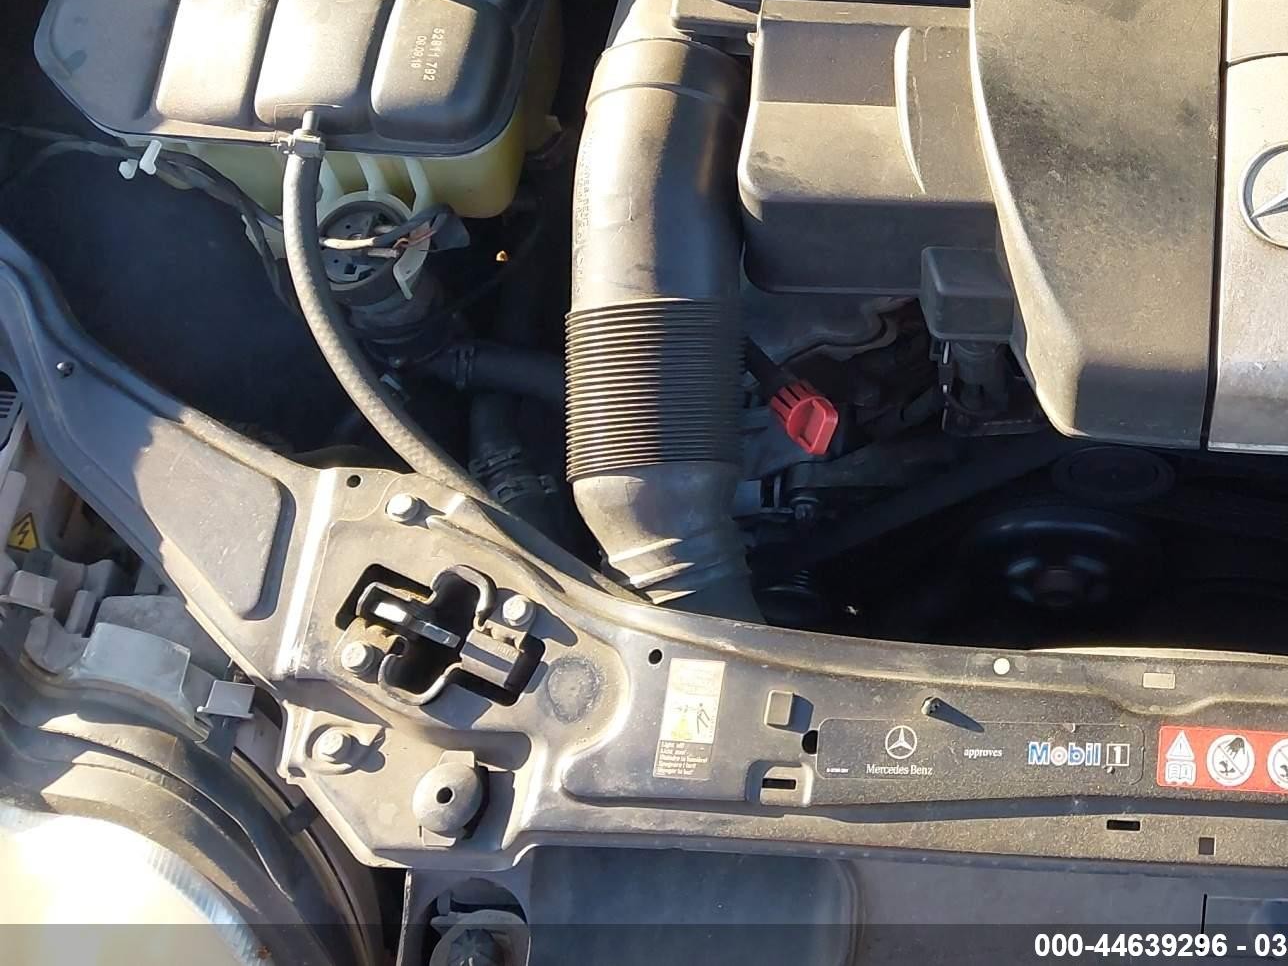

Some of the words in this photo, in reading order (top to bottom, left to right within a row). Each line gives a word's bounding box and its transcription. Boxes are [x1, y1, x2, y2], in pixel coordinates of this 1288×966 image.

[963, 747, 1003, 759] approves
[1028, 742, 1102, 766] Mobil
[866, 763, 909, 775] Mercedes
[910, 764, 933, 775] Benz
